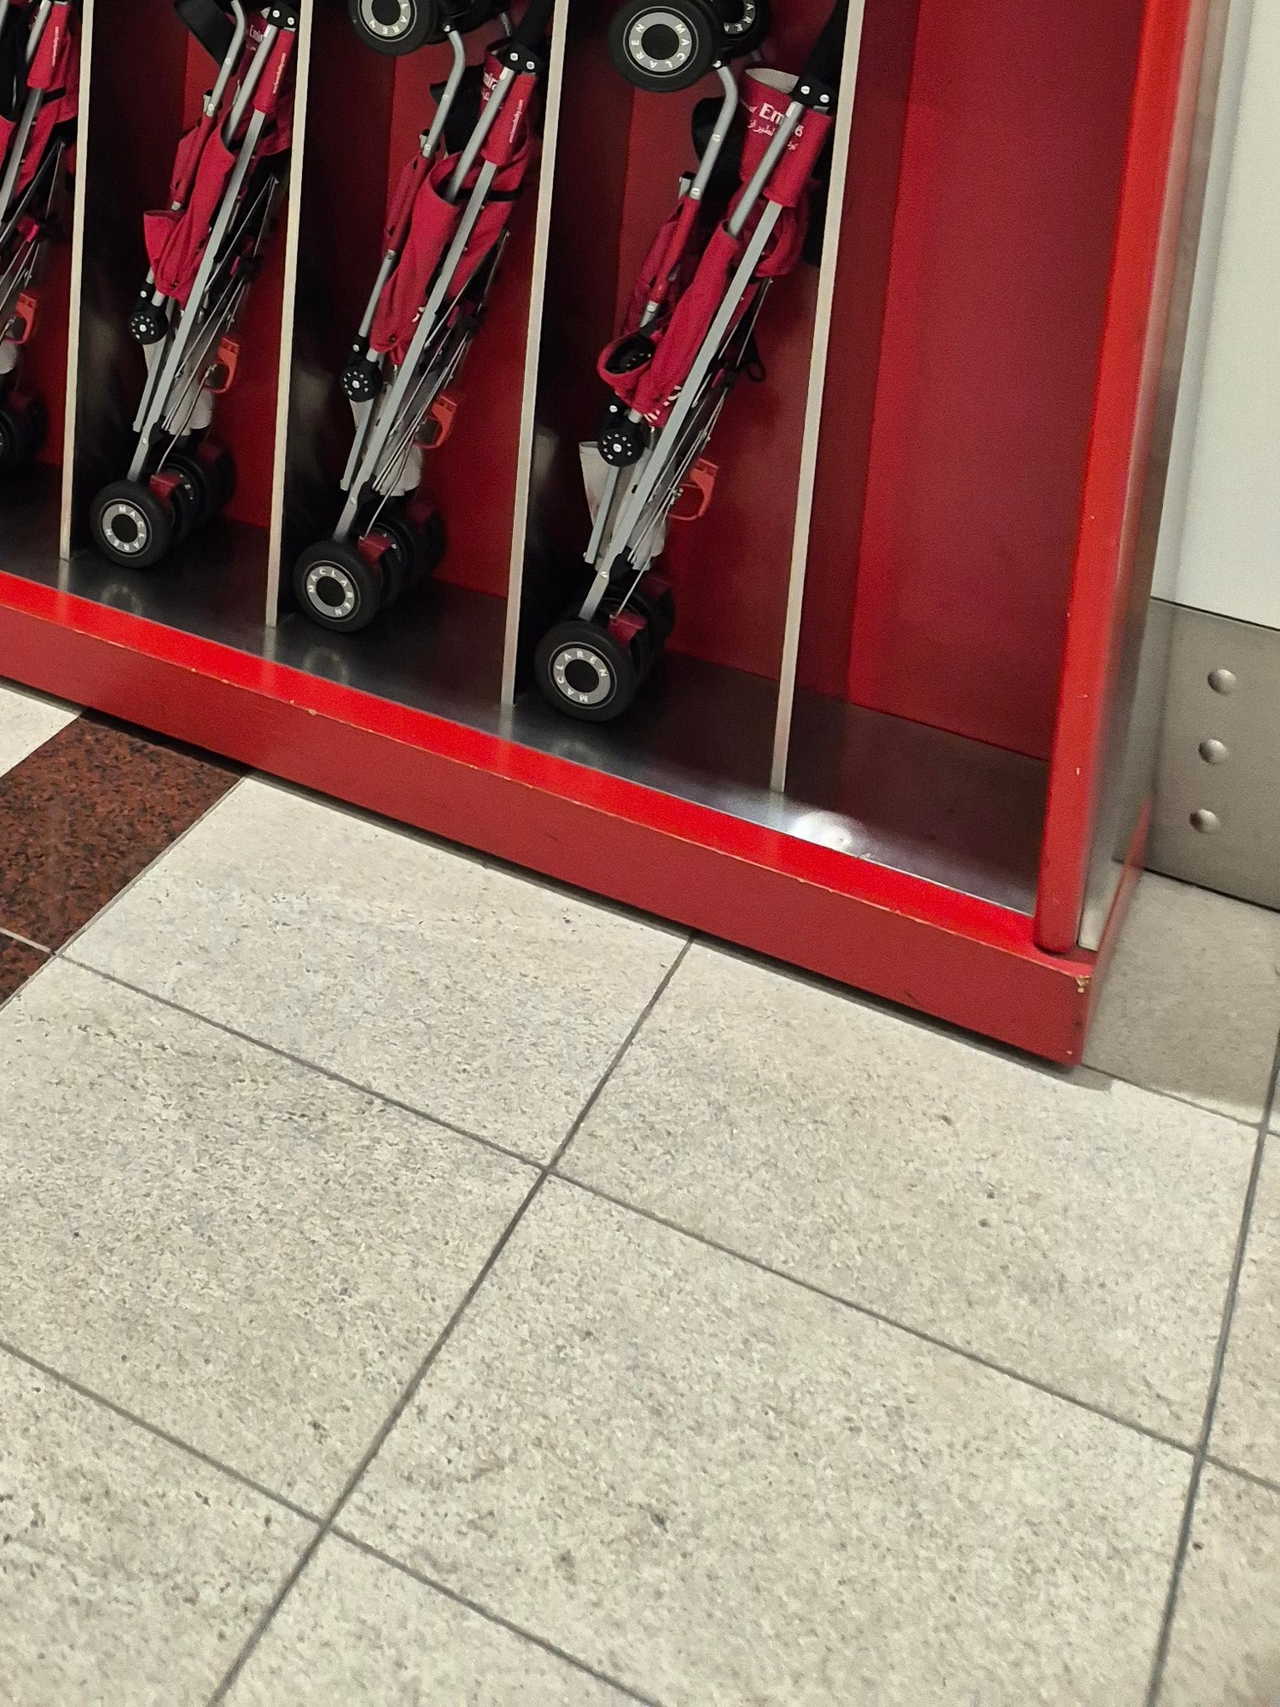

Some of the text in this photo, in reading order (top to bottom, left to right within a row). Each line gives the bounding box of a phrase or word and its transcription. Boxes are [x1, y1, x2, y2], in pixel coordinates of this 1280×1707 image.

[631, 23, 691, 69] MACLAREN
[309, 568, 354, 616] MACLAREN
[556, 650, 607, 703] MACLAREN
